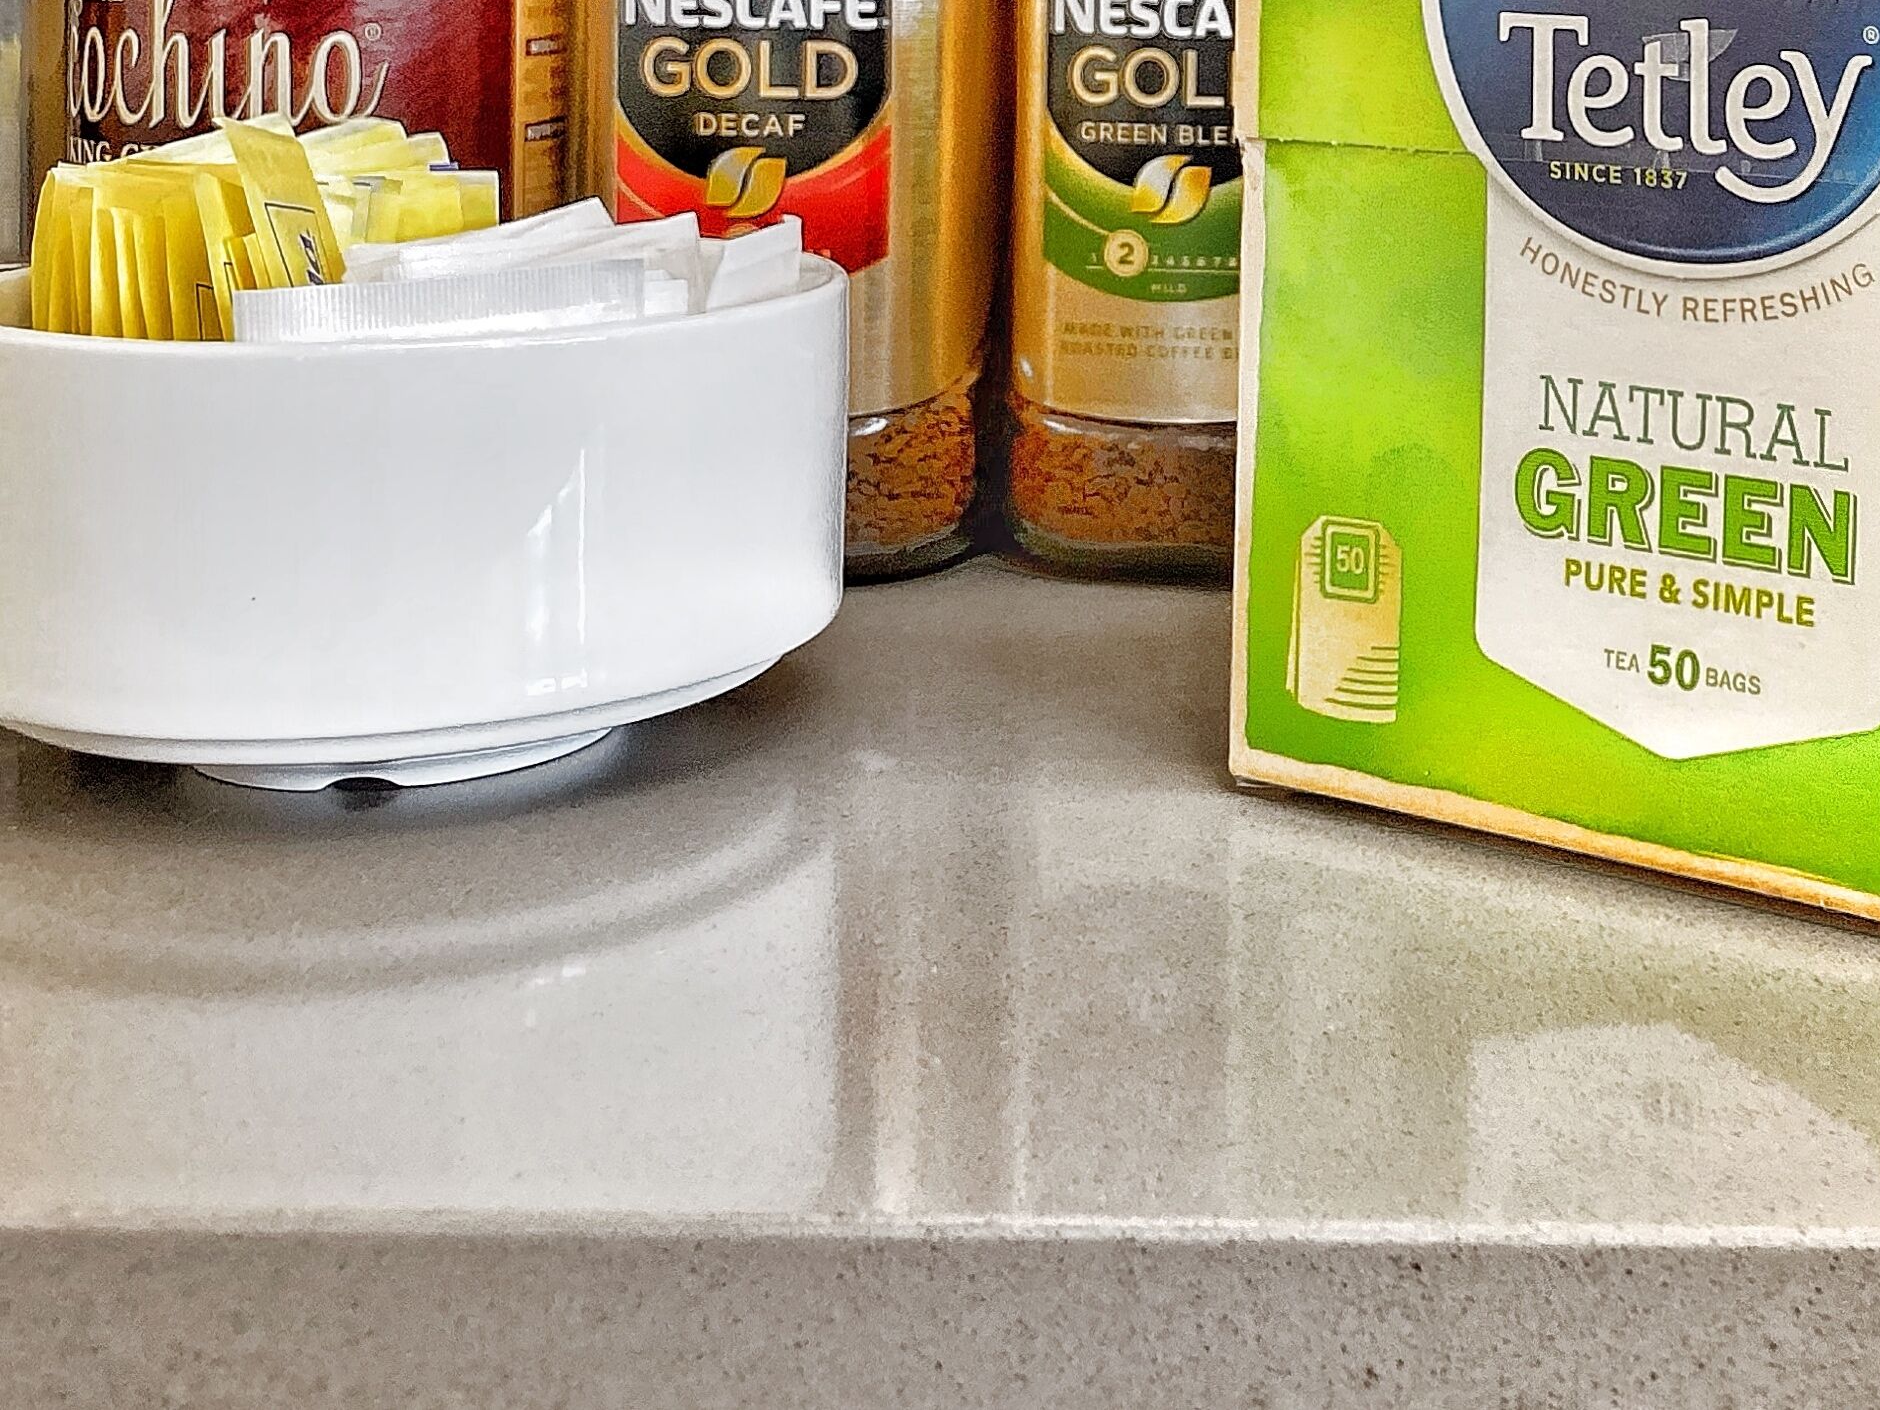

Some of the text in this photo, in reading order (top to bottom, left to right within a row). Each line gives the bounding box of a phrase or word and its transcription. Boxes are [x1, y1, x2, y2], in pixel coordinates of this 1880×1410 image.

[642, 37, 860, 101] GOLD
[1068, 45, 1234, 108] GOL
[694, 113, 806, 139] DECAF
[1081, 121, 1237, 146] GREEN BLE
[1499, 11, 1873, 204] Tetley
[1549, 160, 1688, 189] SINCE 1837
[1117, 242, 1135, 265] 2
[1519, 236, 1876, 324] HONESTLY REFRESHING
[1539, 374, 1849, 473] NATURAL
[1514, 447, 1857, 587] GREEN
[1336, 545, 1365, 575] 50
[1564, 558, 1816, 628] PURE & SIMPLE
[1604, 643, 1762, 696] TEA 50 BAGS
